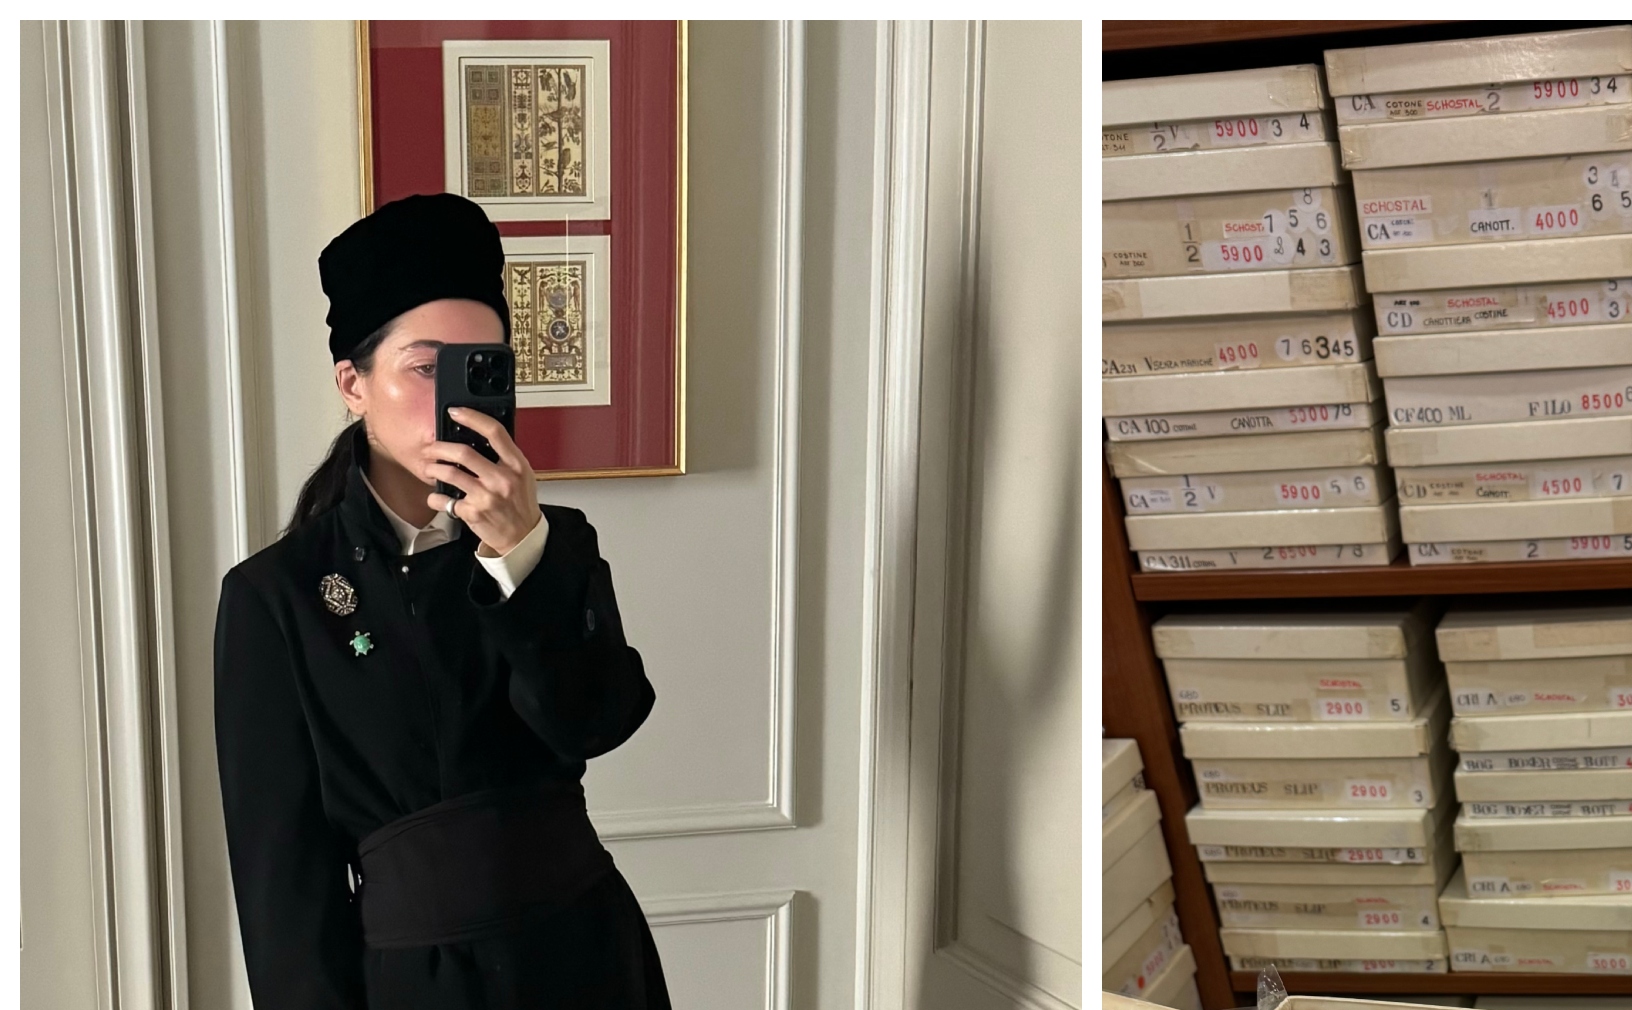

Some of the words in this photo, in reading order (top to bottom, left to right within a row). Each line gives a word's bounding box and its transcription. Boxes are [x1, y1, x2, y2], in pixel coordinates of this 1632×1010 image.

[1352, 95, 1376, 112] CA
[1386, 100, 1422, 109] COTONE
[1427, 99, 1483, 112] SCHOSTAL
[1533, 79, 1579, 99] 5900
[1215, 119, 1259, 138] 5900
[1588, 166, 1599, 185] 3
[1364, 199, 1427, 214] SCHOSTAL
[1592, 193, 1604, 212] 6
[1620, 190, 1632, 208] 5
[1367, 220, 1391, 240] CA
[1535, 209, 1578, 231] 4000
[1221, 244, 1264, 263] 5900
[1296, 238, 1307, 255] 4
[1319, 240, 1331, 257] 3
[1547, 297, 1590, 318] 4500
[1609, 301, 1621, 318] 3
[1388, 311, 1413, 328] CD
[1219, 342, 1259, 362] 4900
[1448, 406, 1472, 421] ML
[1529, 400, 1572, 418] FILO
[1581, 393, 1624, 411] 8500
[1118, 421, 1141, 434] CA
[1144, 419, 1171, 434] 100
[1231, 416, 1274, 430] CANOTTA
[1129, 494, 1150, 508] CA
[1281, 484, 1321, 500] 5900
[1402, 485, 1427, 499] CD
[1542, 478, 1582, 495] 4500
[1418, 543, 1440, 557] CA
[1527, 543, 1540, 558] 2
[1571, 536, 1612, 551] 5900
[1179, 703, 1241, 716] PROTEUS
[1257, 704, 1292, 717] SLIP
[1326, 702, 1363, 715] 2900
[1204, 782, 1268, 794] PROTEUS
[1284, 783, 1319, 794] SLIP
[1351, 786, 1387, 797] 2900
